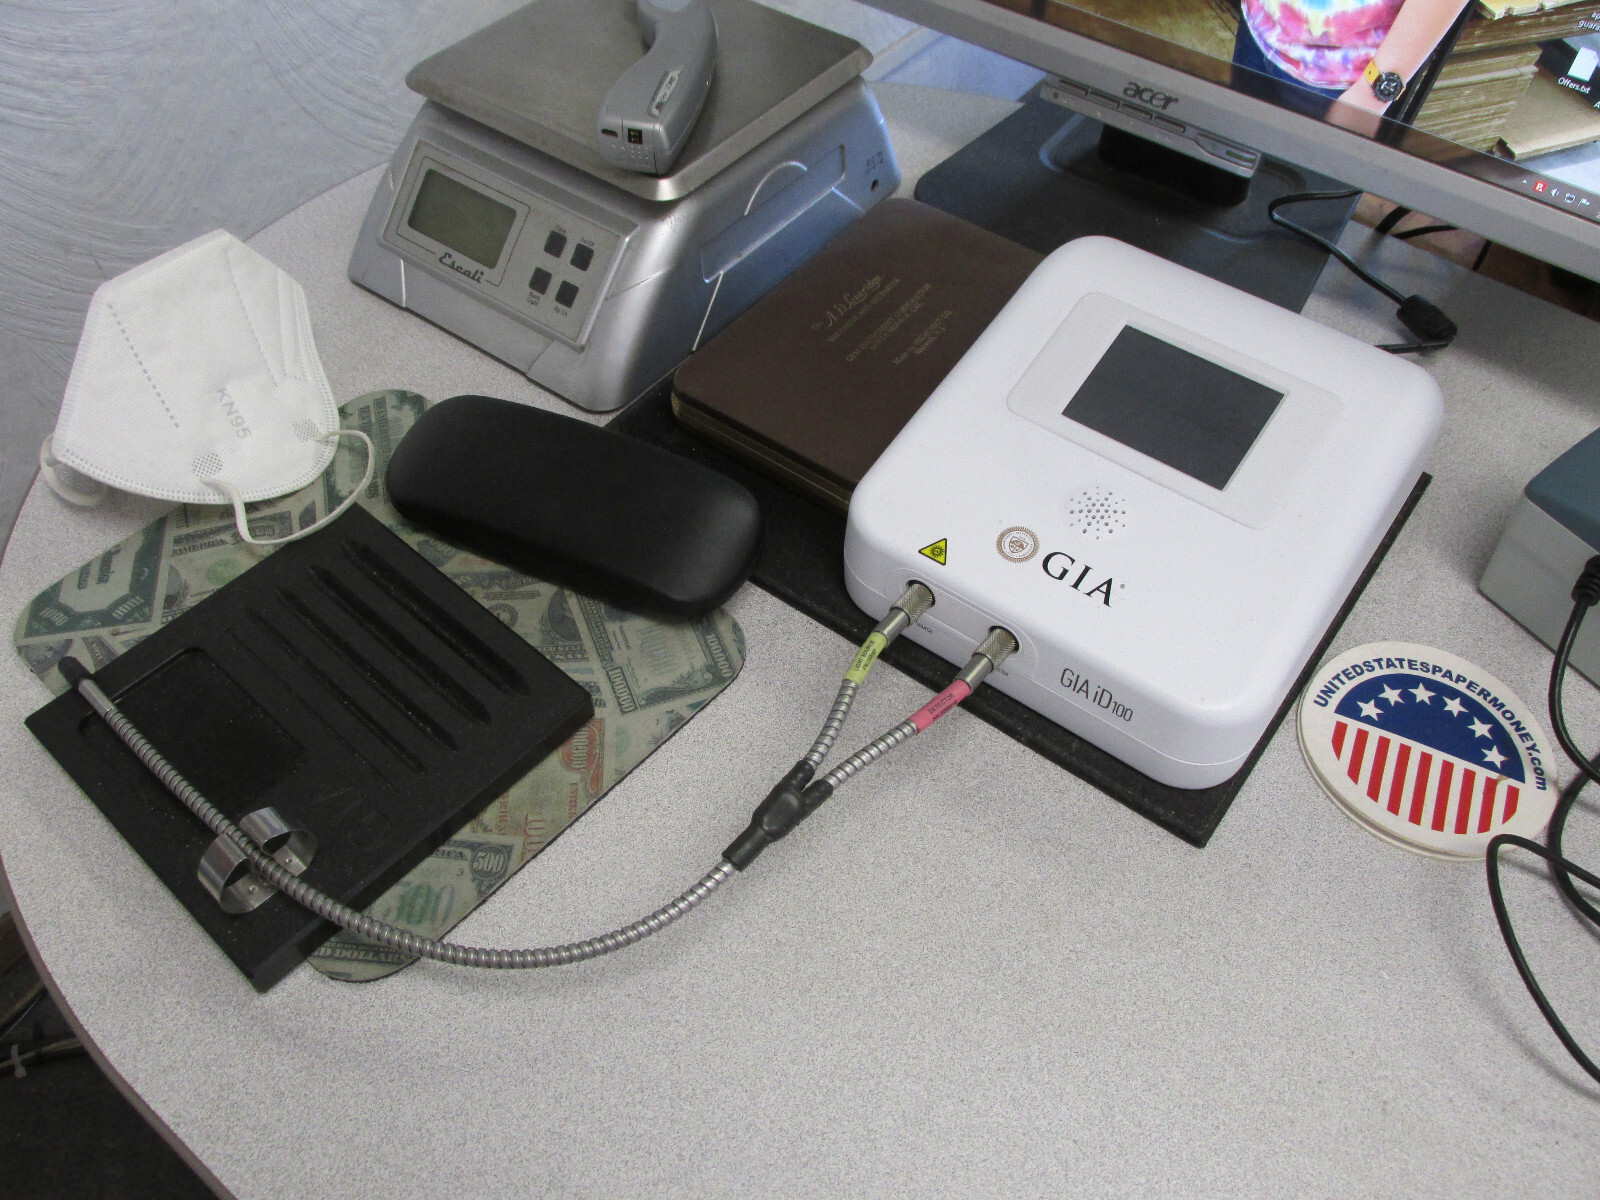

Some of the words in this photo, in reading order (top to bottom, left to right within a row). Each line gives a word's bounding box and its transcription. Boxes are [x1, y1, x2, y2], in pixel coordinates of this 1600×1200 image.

[1125, 81, 1180, 110] acer
[1557, 77, 1591, 95] Offers.txt
[439, 252, 484, 283] Escali
[216, 386, 252, 440] KN95
[1042, 551, 1113, 607] GIA
[1060, 667, 1090, 702] GIA
[927, 692, 955, 715] DETECTOR
[1313, 657, 1547, 791] UNITEDSTATESPAPERMONEY.com
[472, 850, 505, 874] 500
